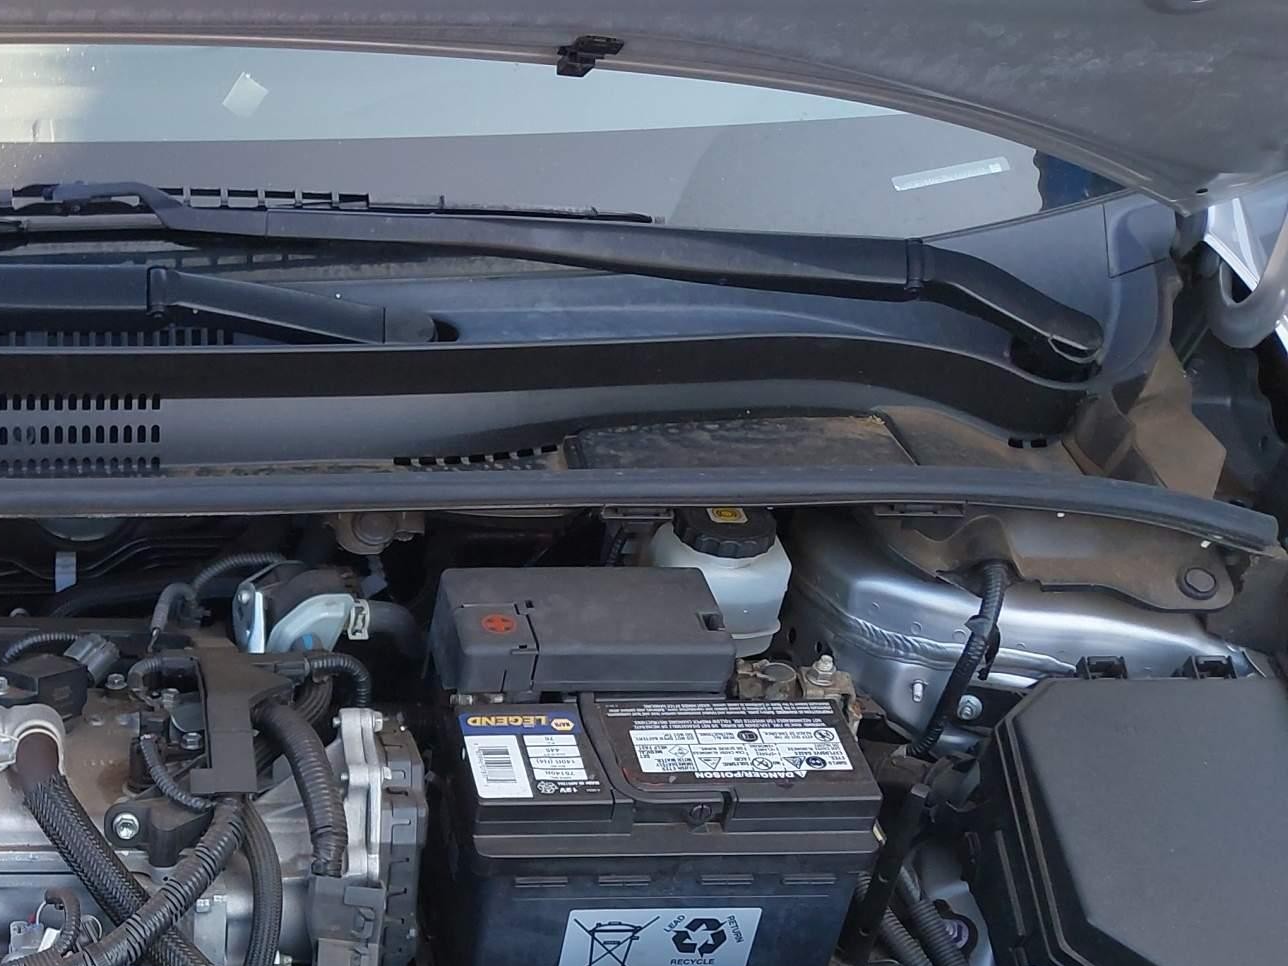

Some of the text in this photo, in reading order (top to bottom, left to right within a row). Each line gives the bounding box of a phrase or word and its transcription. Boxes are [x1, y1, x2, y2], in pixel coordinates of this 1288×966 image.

[467, 715, 546, 727] LEGEND
[694, 771, 795, 779] DANGER/POISON
[664, 914, 686, 933] LEAD
[727, 915, 744, 943] RETURN
